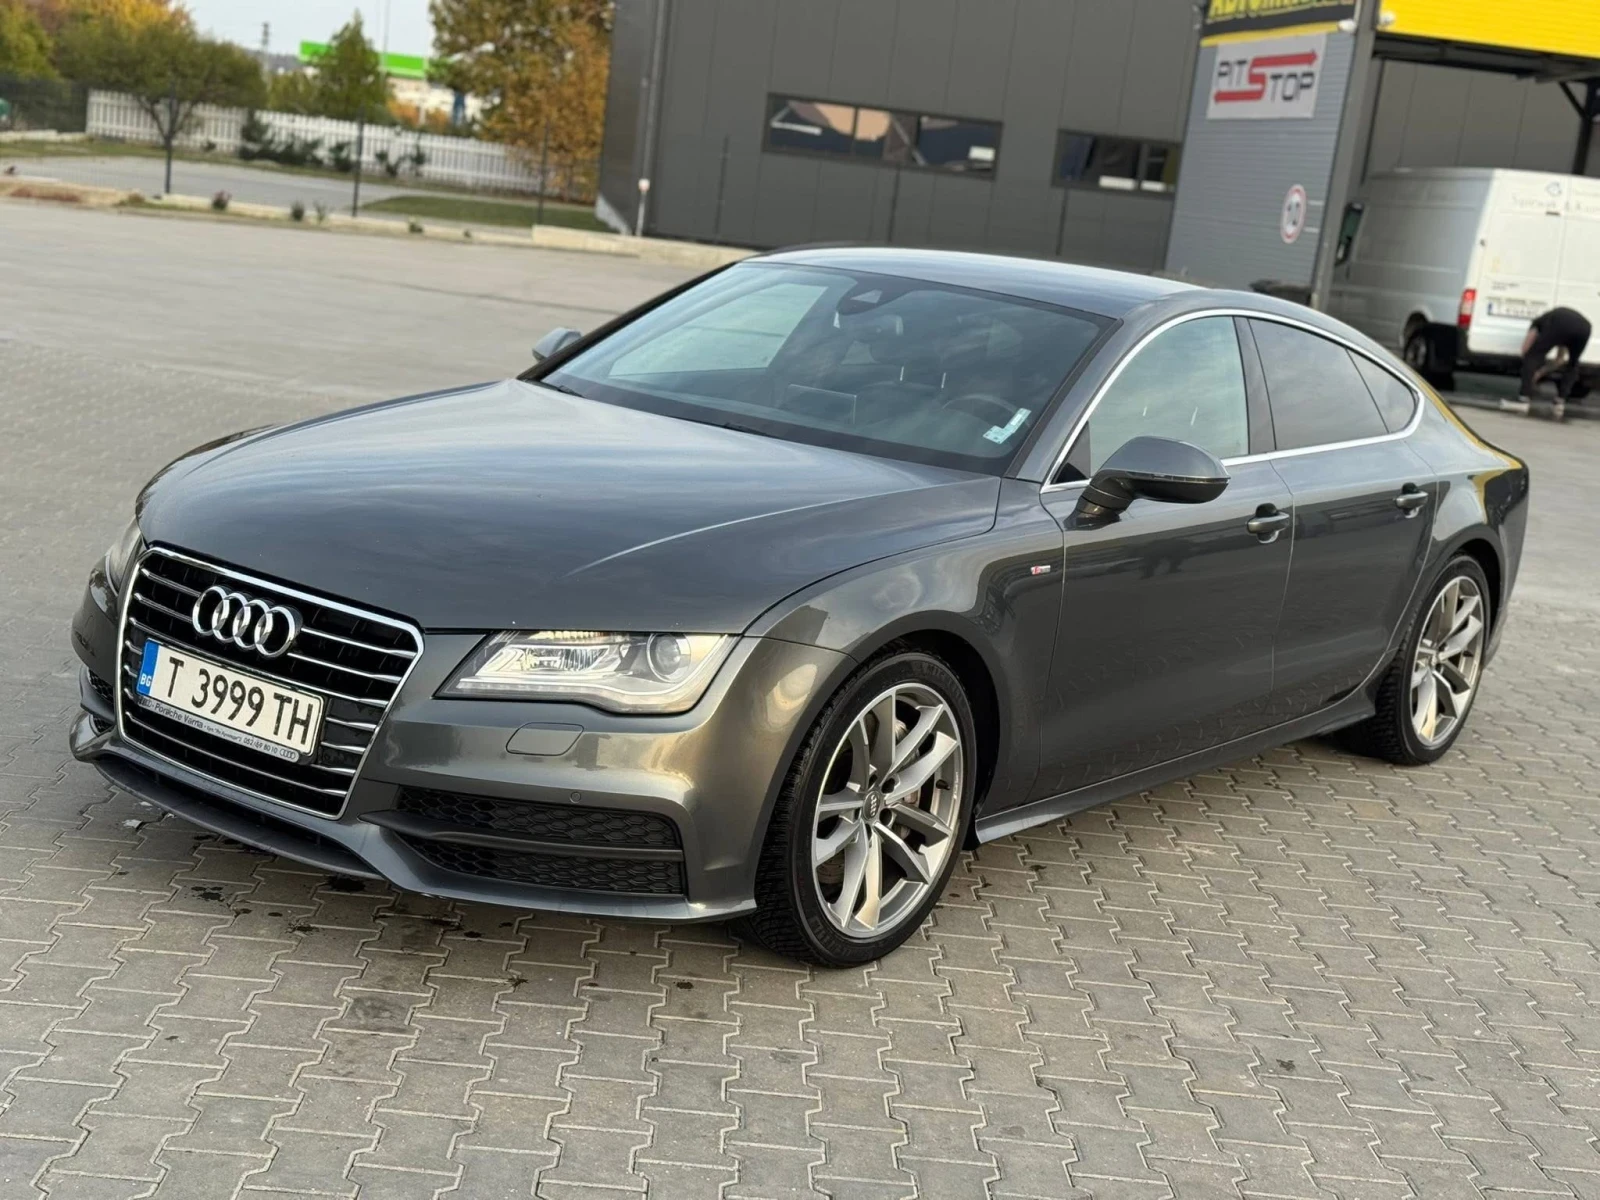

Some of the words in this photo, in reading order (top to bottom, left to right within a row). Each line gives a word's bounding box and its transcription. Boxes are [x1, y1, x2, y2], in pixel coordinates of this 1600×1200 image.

[140, 674, 151, 687] BG
[168, 657, 184, 698] T
[191, 668, 265, 727] 3999
[273, 693, 313, 745] TH
[184, 714, 203, 729] Varna
